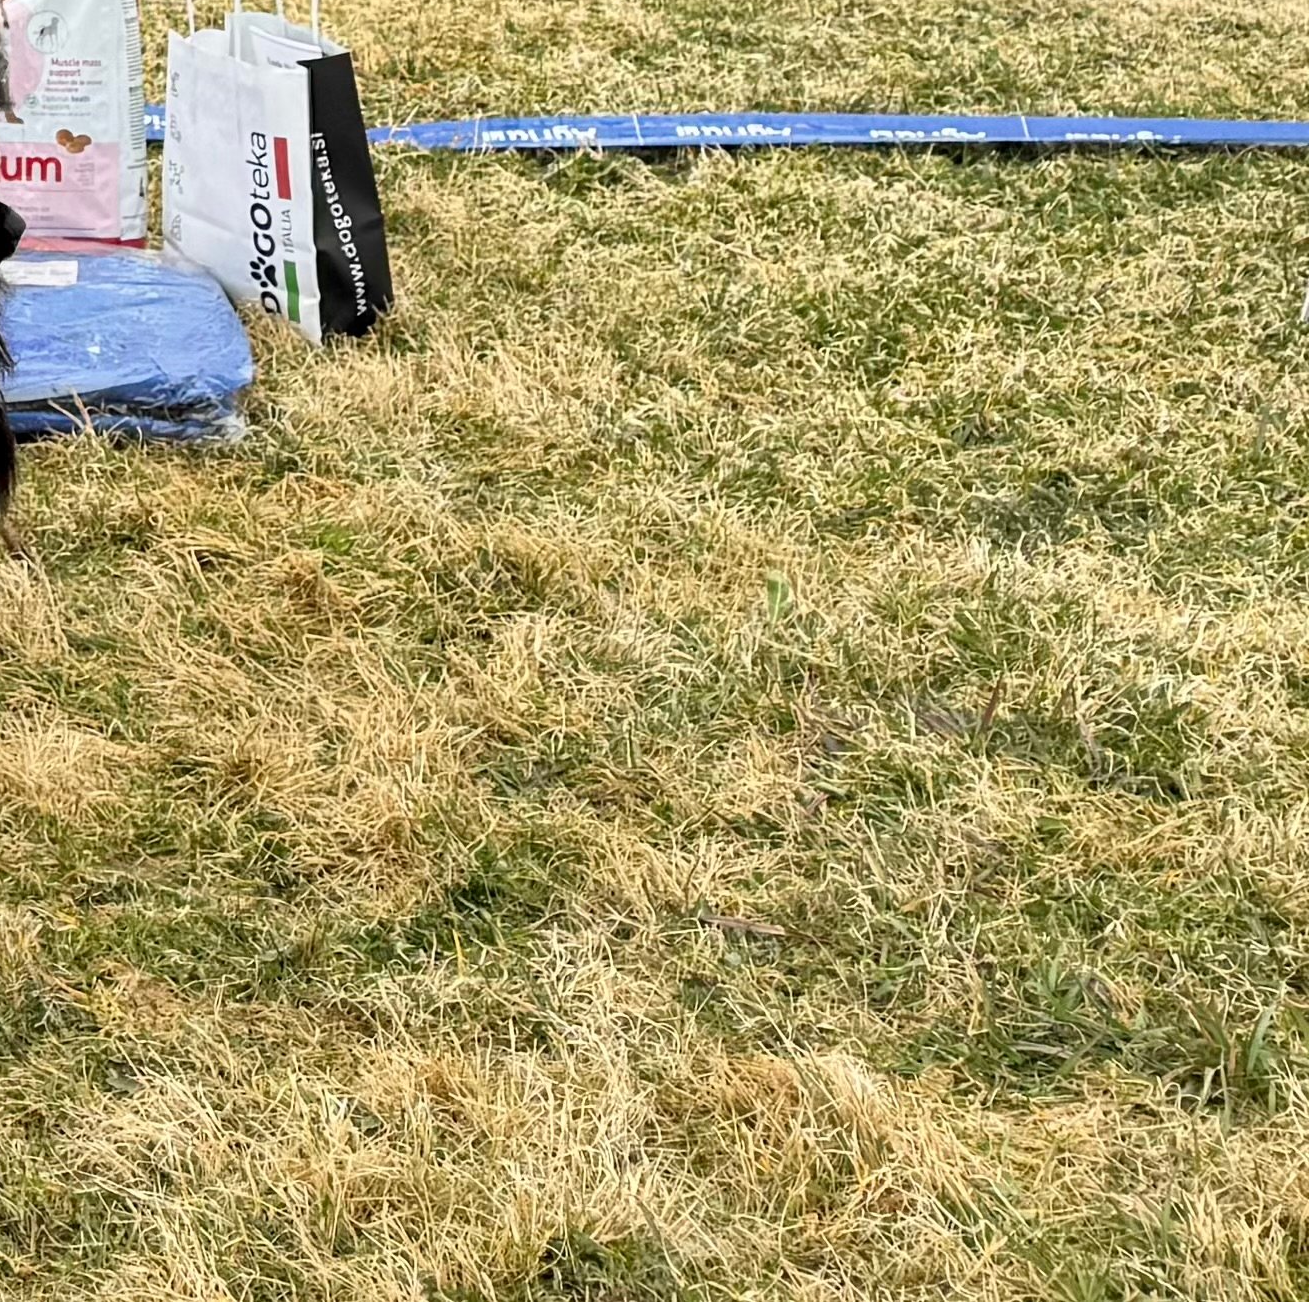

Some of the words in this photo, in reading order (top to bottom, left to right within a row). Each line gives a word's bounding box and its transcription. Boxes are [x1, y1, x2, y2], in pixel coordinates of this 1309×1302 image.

[48, 69, 81, 78] support
[50, 57, 80, 68] Muscle
[281, 208, 294, 254] ITALIA
[309, 131, 368, 317] www.dogoteka.si
